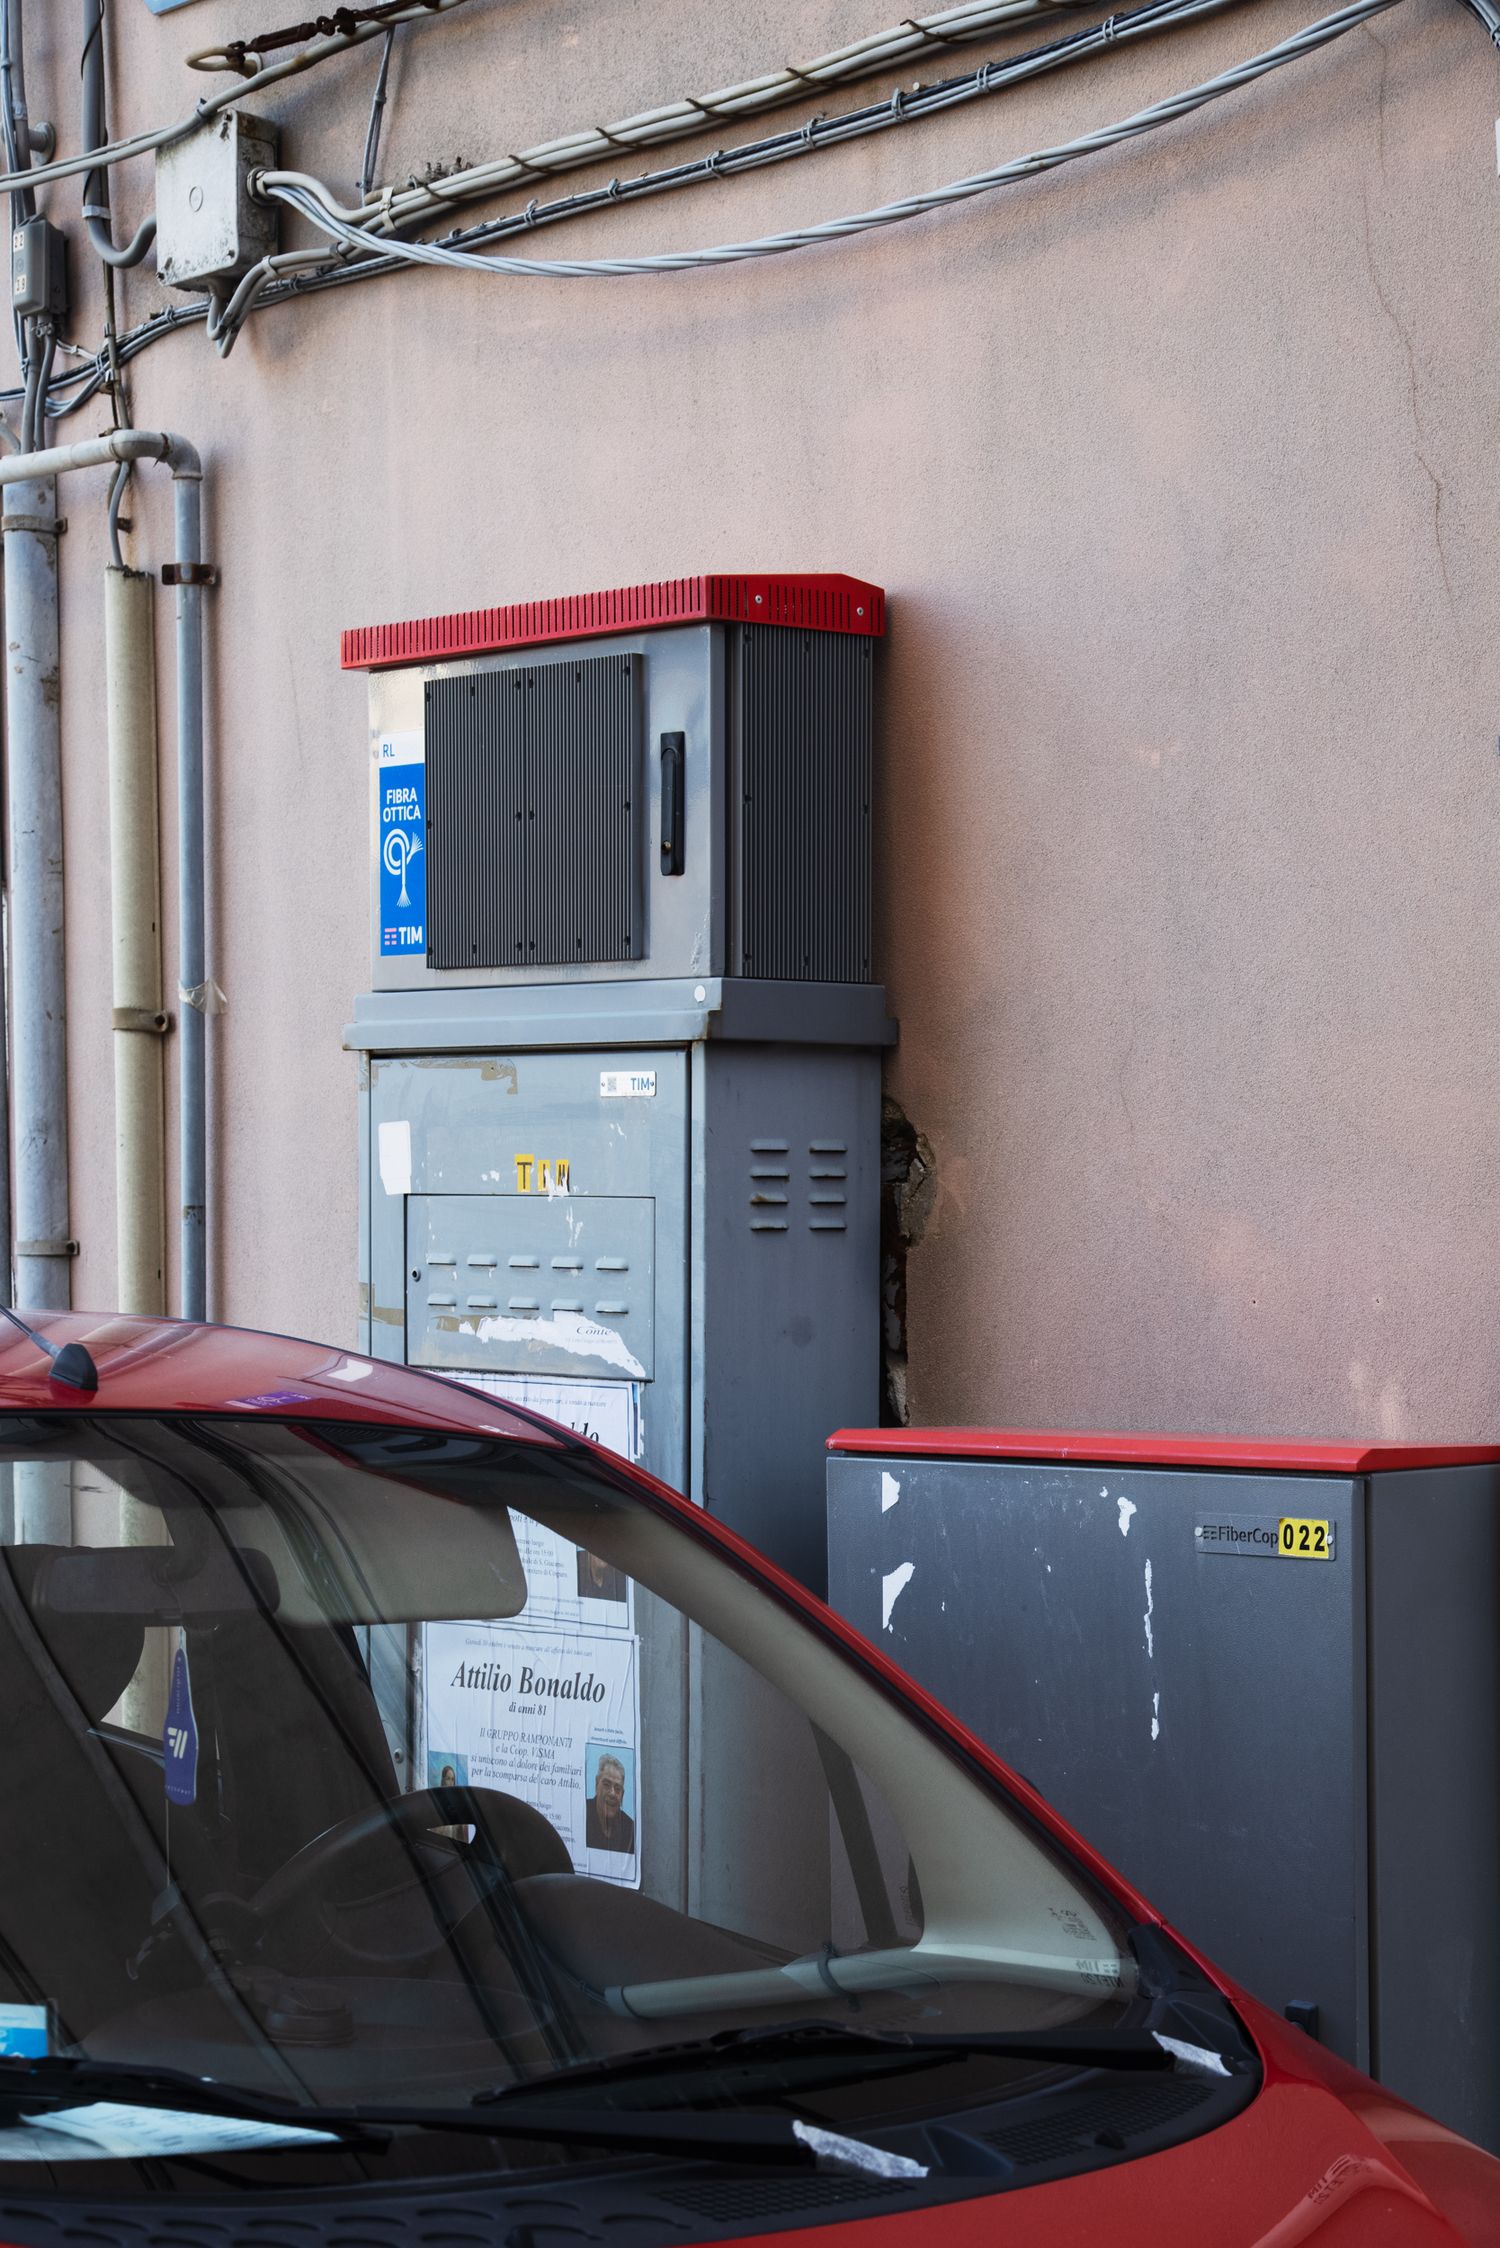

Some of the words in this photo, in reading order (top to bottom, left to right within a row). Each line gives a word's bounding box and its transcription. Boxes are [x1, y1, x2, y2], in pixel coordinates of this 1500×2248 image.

[382, 744, 395, 758] RL
[386, 787, 418, 805] FIBRA
[383, 804, 421, 823] OTTICA
[398, 925, 423, 945] TIM
[630, 1076, 650, 1091] TIM
[1218, 1525, 1278, 1548] FiberCop
[1283, 1523, 1326, 1552] 022
[450, 1660, 512, 1693] Attilio
[518, 1666, 606, 1703] Bonaldo
[508, 1701, 516, 1713] di
[518, 1704, 536, 1715] anni
[537, 1704, 547, 1716] 81
[486, 1728, 519, 1742] GRUPPO
[495, 1745, 500, 1753] e
[501, 1743, 508, 1754] la
[471, 1754, 477, 1763] si
[478, 1755, 508, 1766] uniscono
[509, 1757, 516, 1767] al
[517, 1759, 538, 1771] dolore
[539, 1762, 551, 1772] dei
[550, 1763, 582, 1776] familiari
[471, 1767, 484, 1777] per
[484, 1766, 491, 1777] la
[492, 1770, 528, 1782] scomparsa
[528, 1774, 540, 1784] del
[540, 1778, 557, 1786] caro
